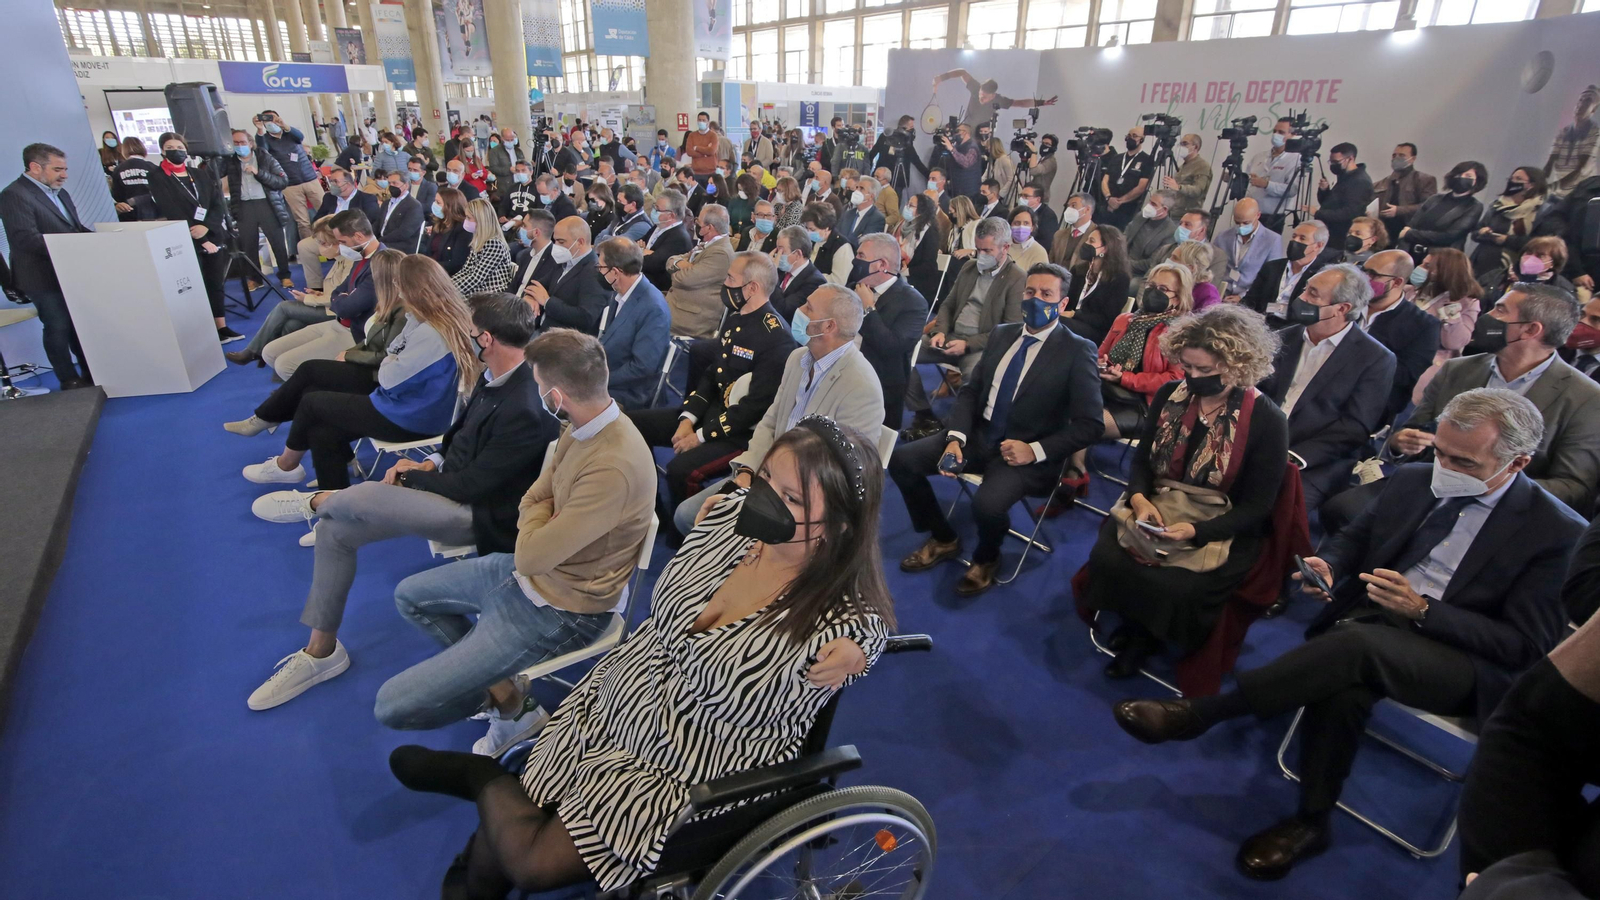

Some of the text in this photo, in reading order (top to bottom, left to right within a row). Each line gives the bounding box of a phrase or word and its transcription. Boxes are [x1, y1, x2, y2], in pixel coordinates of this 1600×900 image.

[80, 61, 110, 70] MOVE-IT
[262, 63, 312, 88] Forus
[1140, 78, 1343, 103] I FERIA DEL DEPORTE
